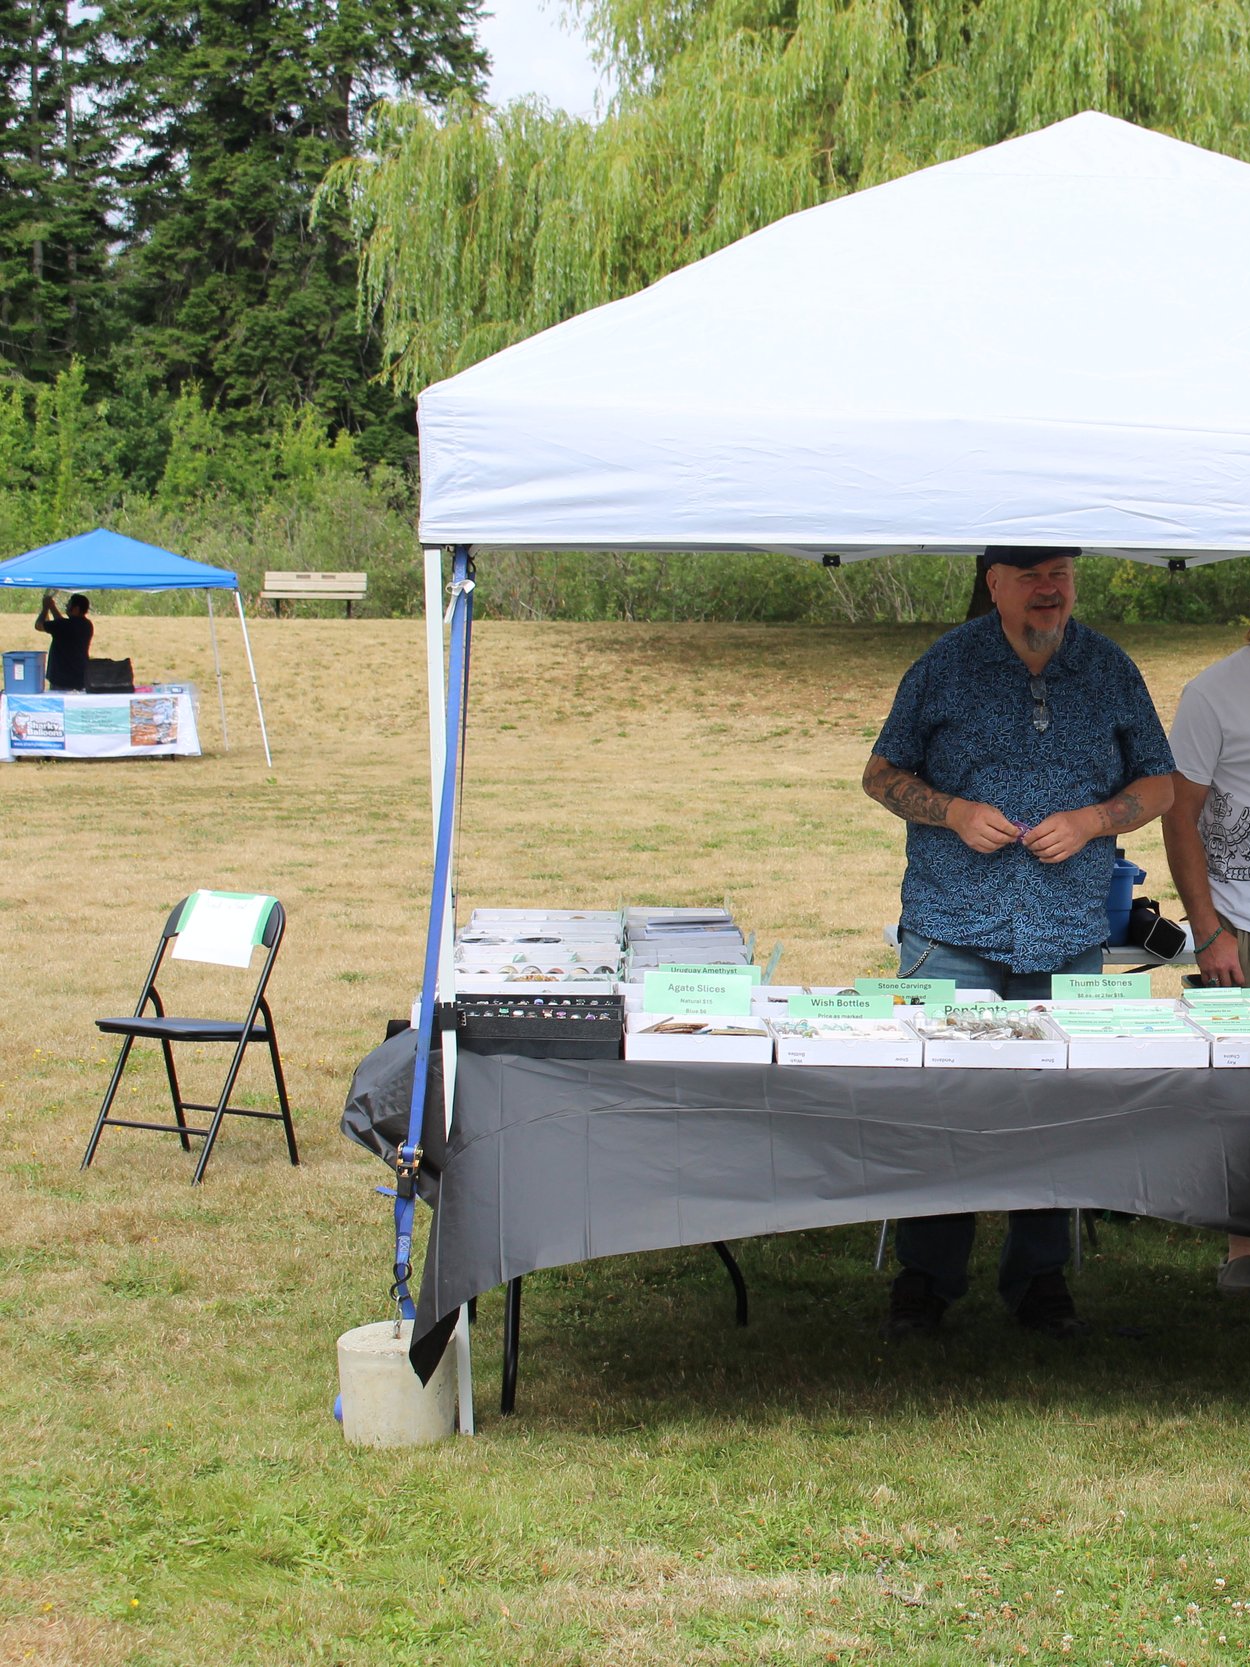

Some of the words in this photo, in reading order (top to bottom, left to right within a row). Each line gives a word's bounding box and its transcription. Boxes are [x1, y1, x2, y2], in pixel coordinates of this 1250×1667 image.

[27, 728, 64, 737] Balloons
[702, 967, 738, 975] Amethyst
[878, 982, 899, 990] Stone
[900, 982, 932, 990] Carvings
[1069, 979, 1100, 987] Thumb
[1102, 979, 1133, 987] Stones
[668, 983, 695, 994] Agate
[697, 984, 727, 994] Slices
[811, 998, 835, 1007] Wish
[836, 999, 870, 1008] Bottles
